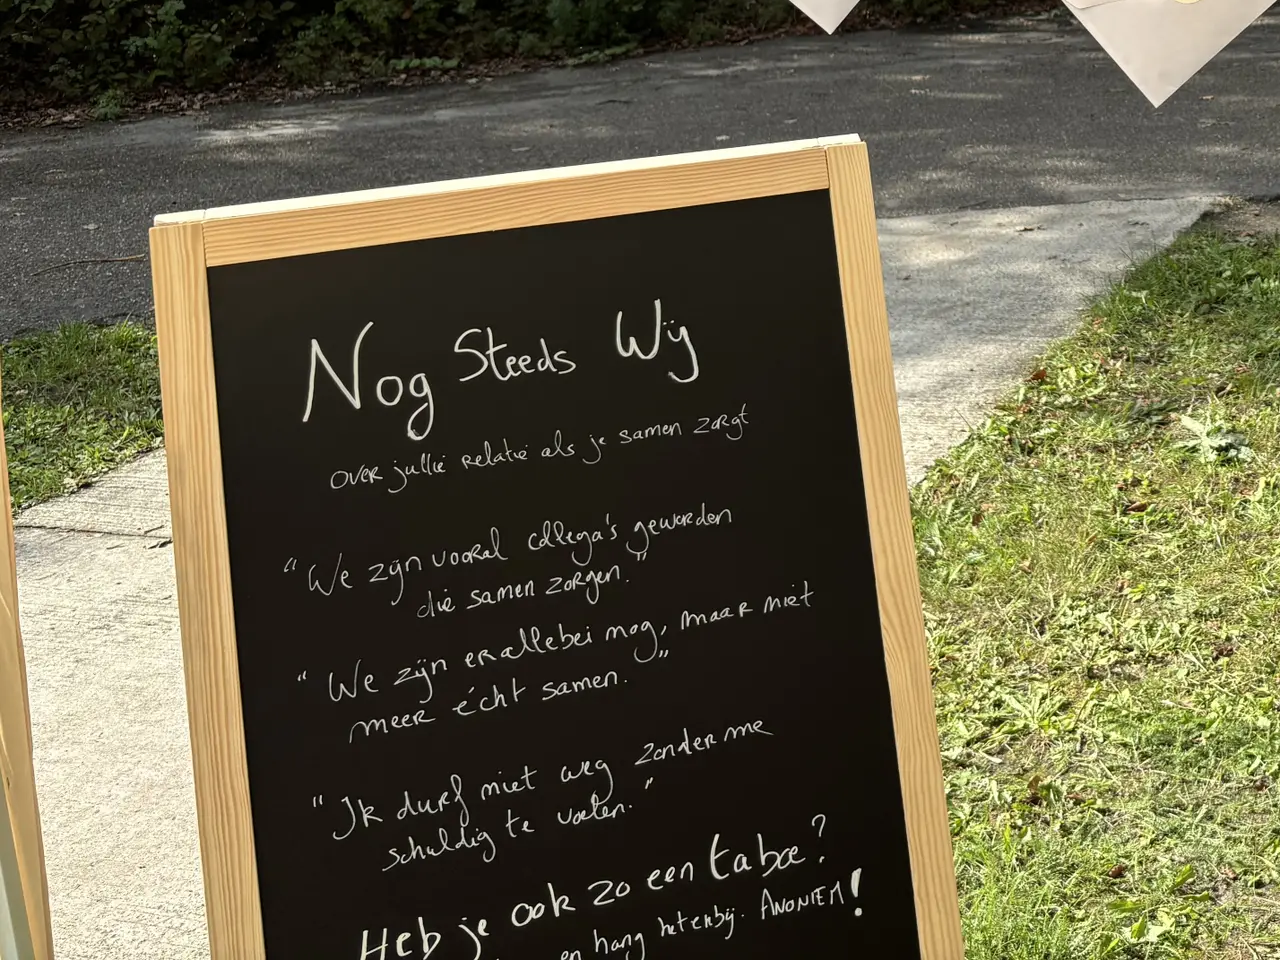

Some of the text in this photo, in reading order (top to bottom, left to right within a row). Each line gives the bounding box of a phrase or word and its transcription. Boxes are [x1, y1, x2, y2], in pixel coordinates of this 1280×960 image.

[303, 299, 700, 440] Nog Steeds Wij
[330, 403, 751, 494] over jullie relatie als je samen zorgt
[368, 555, 422, 606] zijn
[432, 526, 508, 568] vooral
[625, 502, 732, 555] geworden
[416, 589, 457, 619] die
[466, 579, 535, 610] samen
[393, 657, 448, 704] zijn
[681, 602, 754, 631] maar
[763, 580, 814, 614] niet
[349, 709, 436, 744] meer
[396, 773, 470, 827] durf
[480, 766, 538, 801] niet
[560, 759, 615, 806] weg
[634, 727, 717, 766] zonder
[723, 720, 774, 742] me
[381, 826, 496, 872] schuldig
[505, 808, 535, 838] te
[359, 916, 442, 960] Heb
[458, 916, 491, 960] je
[511, 882, 577, 927] ook
[587, 879, 631, 906] zo
[646, 861, 694, 891] een
[593, 928, 646, 960] hang
[761, 867, 863, 920] ANONIEM!
